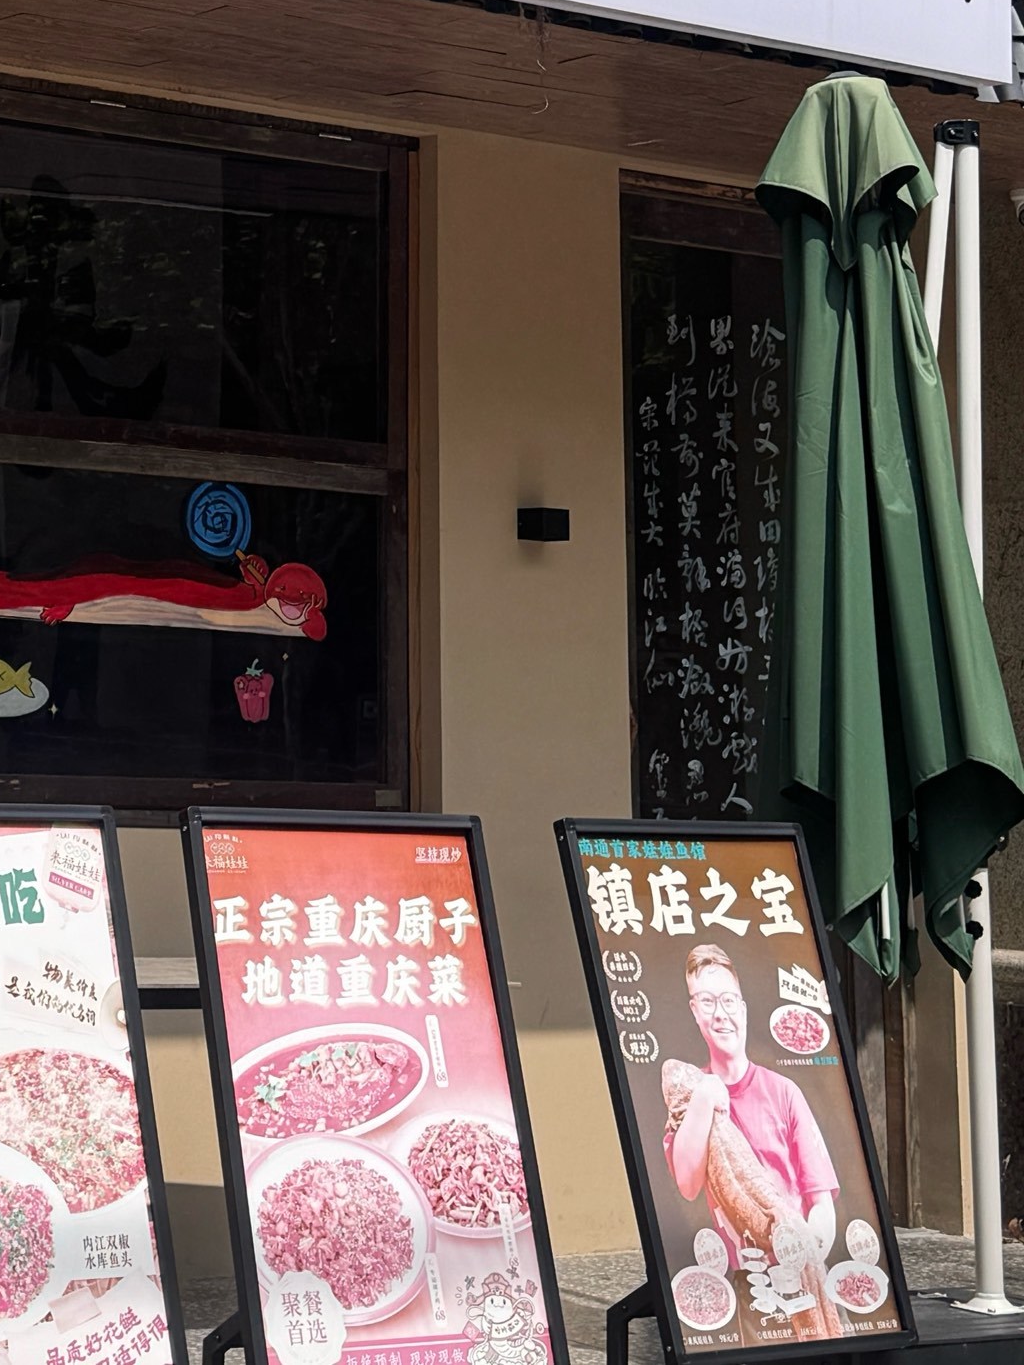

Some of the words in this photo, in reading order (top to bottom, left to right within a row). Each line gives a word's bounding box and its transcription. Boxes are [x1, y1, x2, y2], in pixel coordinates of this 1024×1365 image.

[415, 846, 462, 863] 坚持现炒
[586, 863, 804, 937] 镇店之宝
[213, 893, 477, 945] 正宗重庆厨子
[241, 953, 467, 1005] 地道重庆菜
[85, 1251, 132, 1269] 水库鱼头
[281, 1290, 323, 1317] 聚餐
[285, 1319, 328, 1346] 首选
